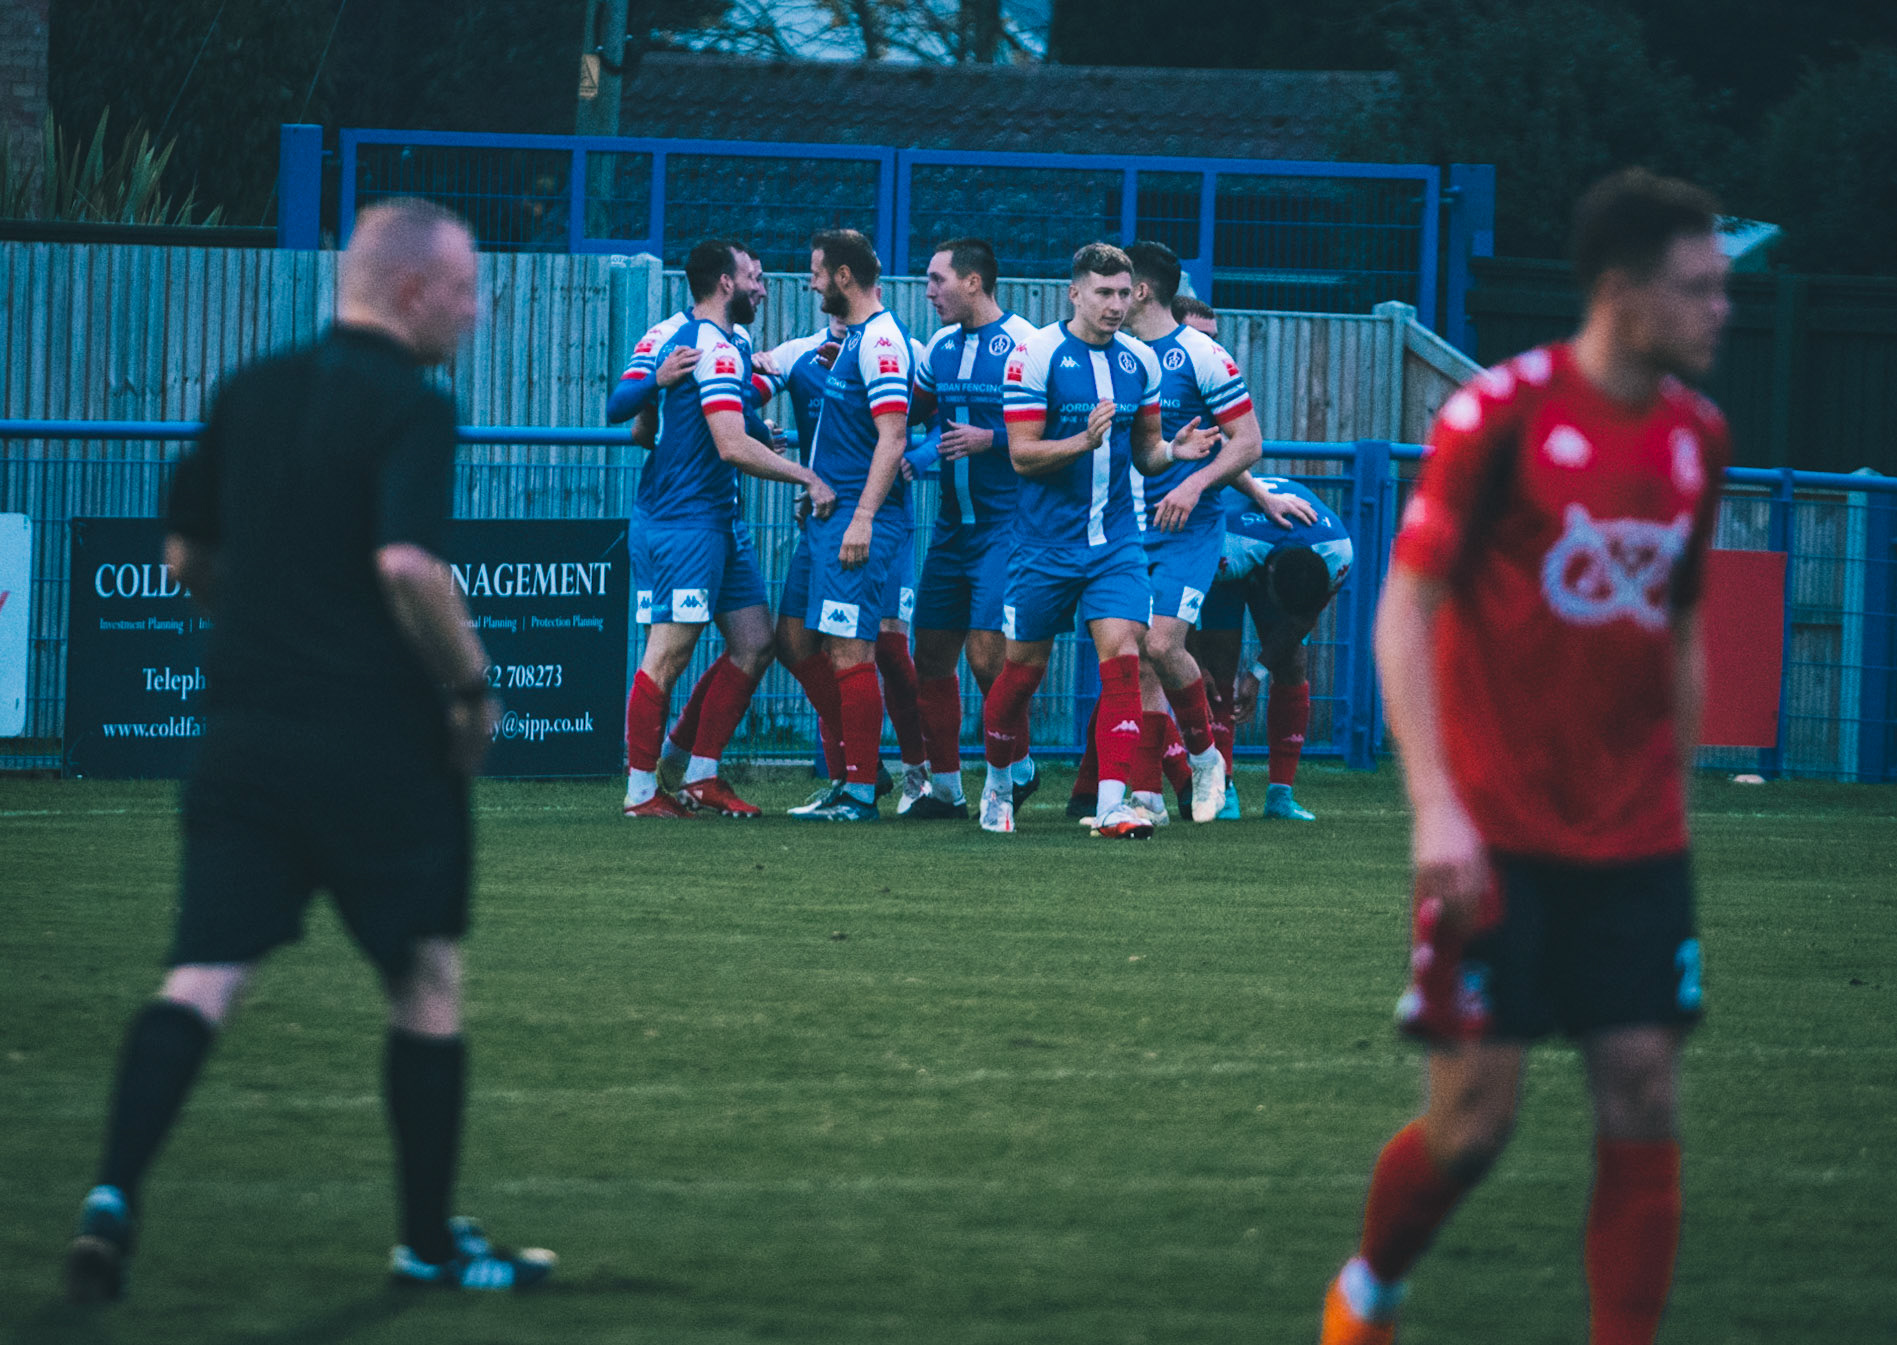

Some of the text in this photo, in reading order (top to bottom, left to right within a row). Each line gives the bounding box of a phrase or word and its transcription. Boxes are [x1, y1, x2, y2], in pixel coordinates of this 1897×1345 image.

[1060, 403, 1096, 413] JORDA
[94, 562, 611, 598] COLD NAGEMENT
[100, 618, 145, 630] Investment
[148, 617, 184, 634] Planning
[483, 617, 517, 632] Planning
[531, 616, 571, 628] Protection
[572, 616, 603, 631] Planning
[142, 667, 206, 699] Teleph
[507, 664, 562, 688] 708273
[102, 711, 593, 742] www.coldfai y@sjpp.co.uk
